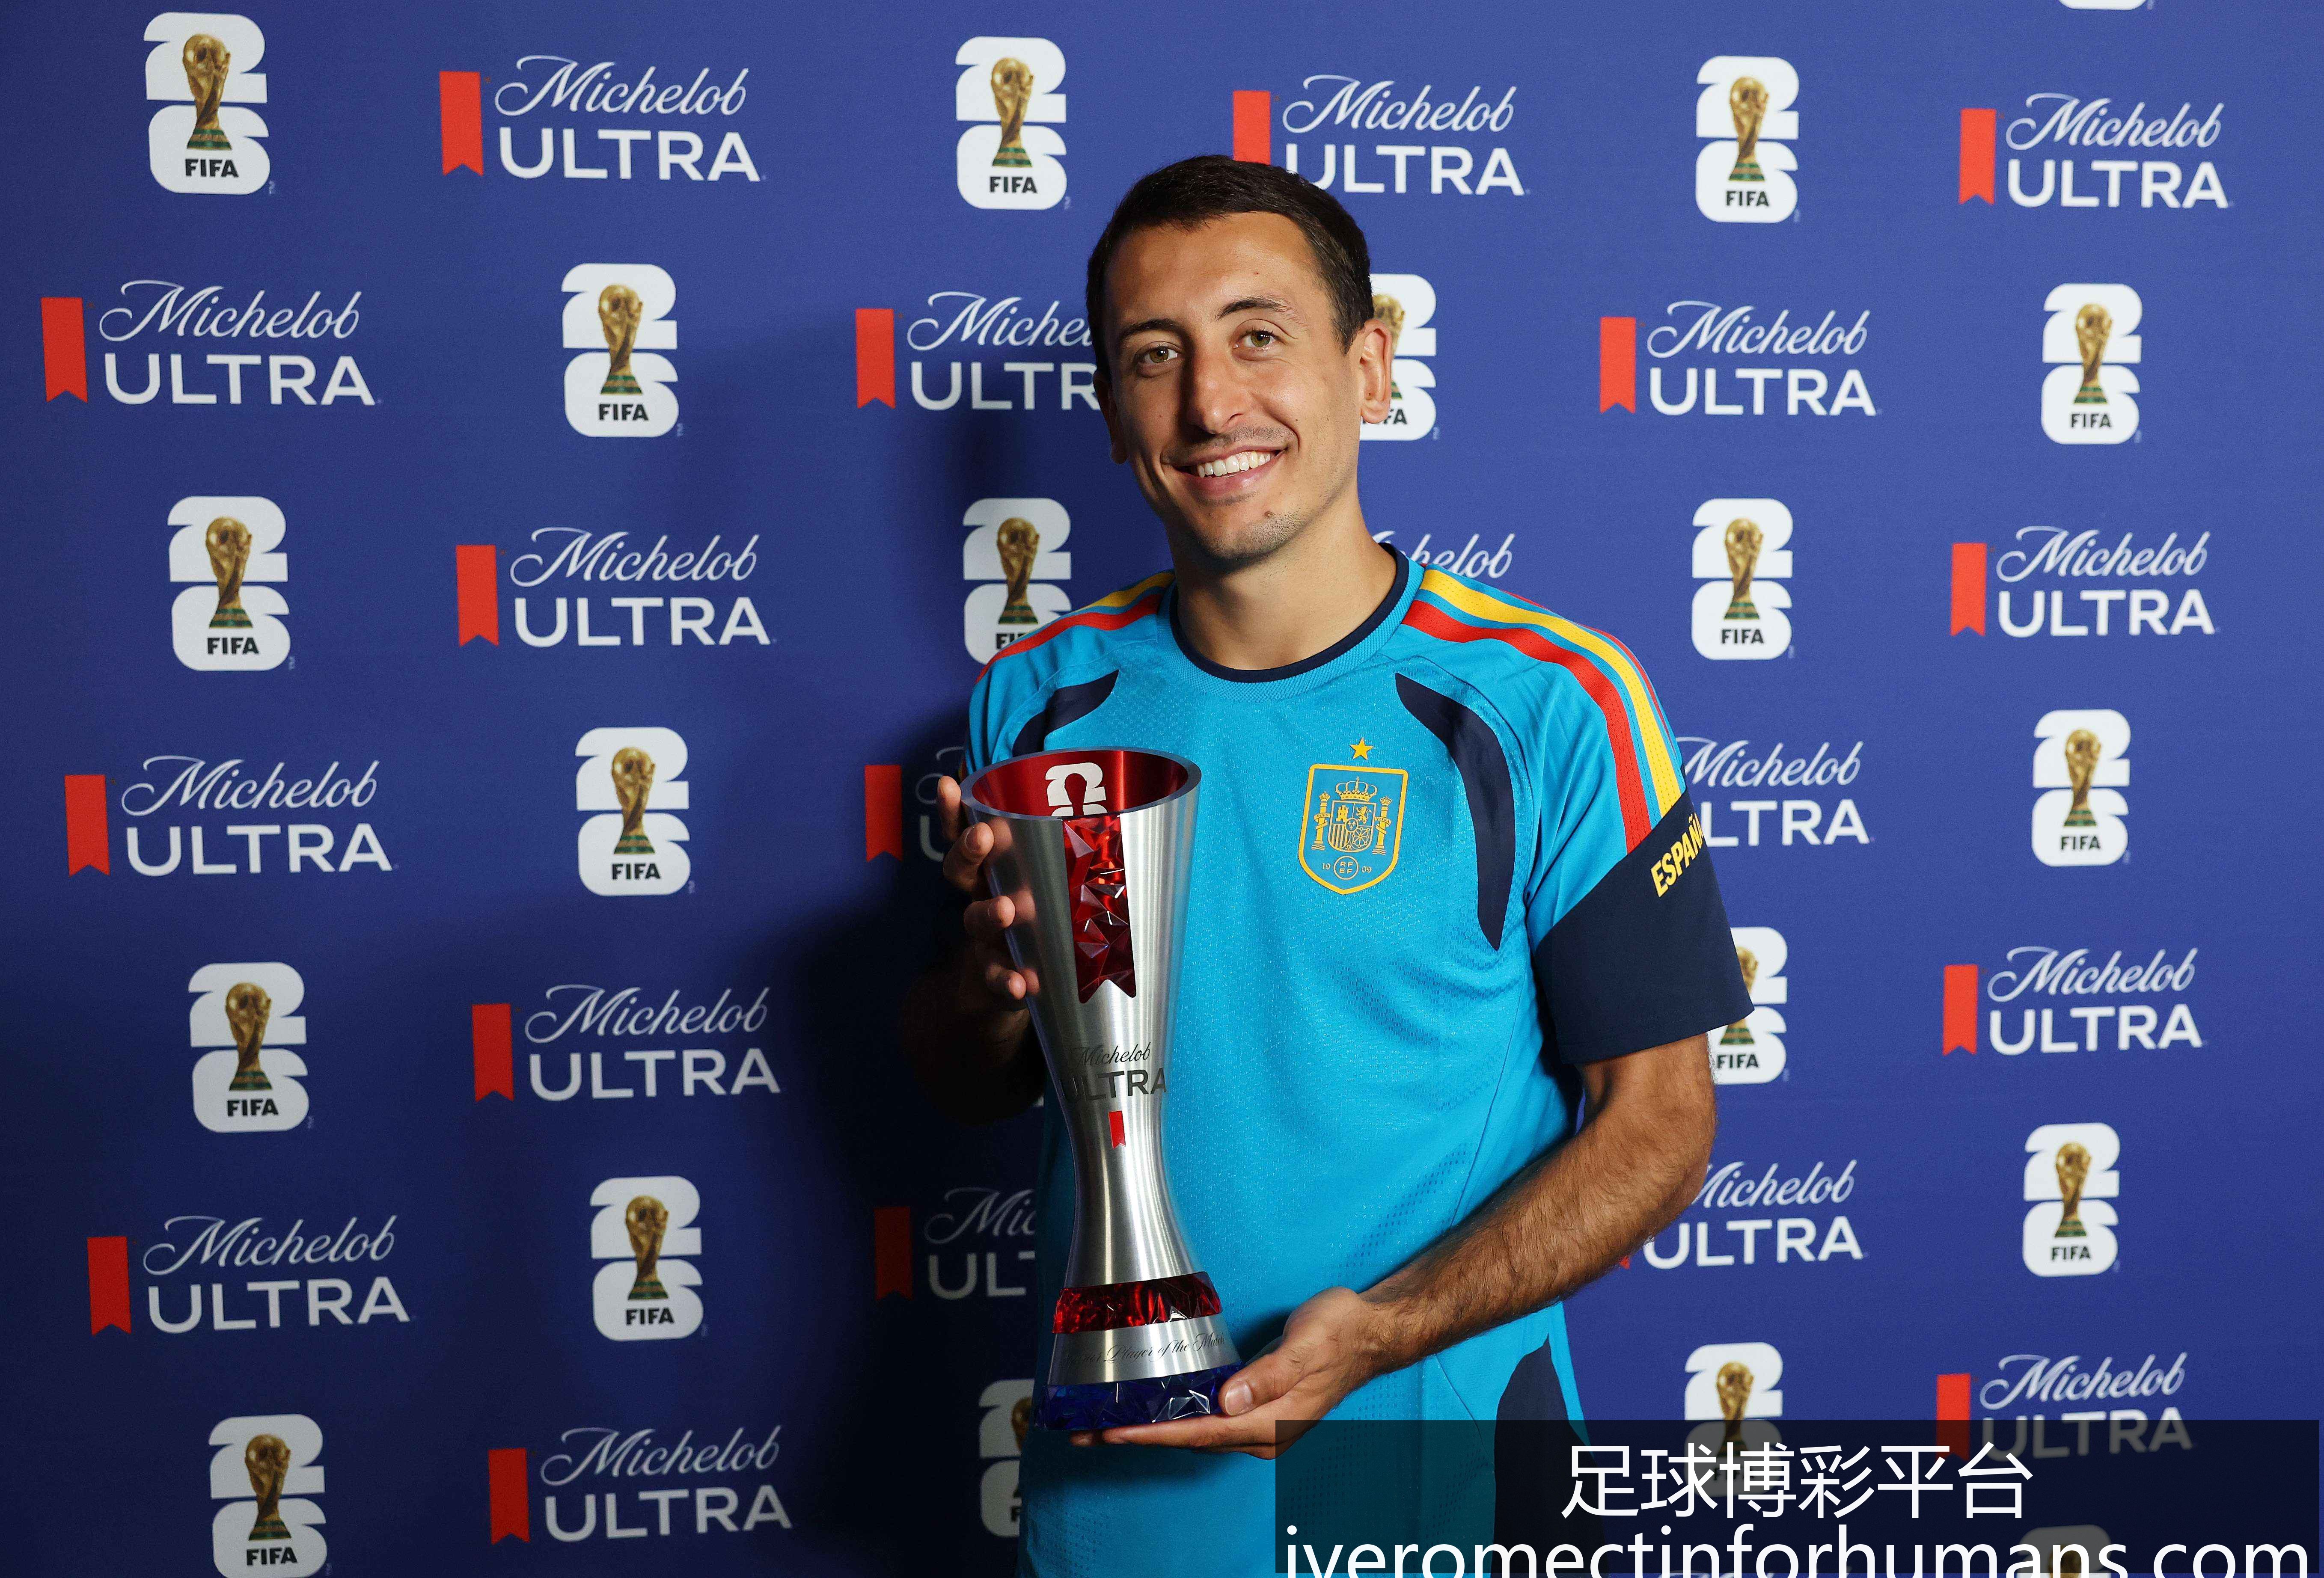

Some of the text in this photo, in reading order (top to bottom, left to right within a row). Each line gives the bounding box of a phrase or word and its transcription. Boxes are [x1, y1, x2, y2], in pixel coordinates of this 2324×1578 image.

[495, 56, 749, 116] Michelob
[1283, 75, 1516, 133] Michelob
[2006, 93, 2224, 150] Michelob
[185, 159, 238, 177] FIFA
[500, 127, 760, 181] ULTRA
[1286, 144, 1524, 196] ULTRA
[990, 176, 1037, 193] FIFA
[1727, 191, 1769, 206] FIFA
[2008, 159, 2228, 208] ULTRA
[100, 280, 361, 341] Michelob
[907, 291, 1091, 350] Miche
[1647, 301, 1870, 358] Michelob
[105, 353, 375, 405] ULTRA
[911, 361, 1100, 410] ULTR
[1650, 368, 1876, 415] ULTRA
[599, 404, 648, 421] FIFA
[2071, 413, 2111, 427] FIFA
[511, 528, 759, 587] Michelob
[1997, 526, 2210, 582] Michelob
[515, 597, 770, 647] ULTRA
[1722, 629, 1764, 644] FIFA
[1999, 589, 2214, 638] ULTRA
[207, 638, 259, 654] FIFA
[122, 756, 379, 816] Michelob
[1700, 799, 1870, 847] LTRA
[2061, 836, 2101, 850] FIFA
[127, 824, 392, 876] ULTRA
[612, 863, 660, 880] FIFA
[1988, 946, 2197, 1002] Michelob
[525, 985, 768, 1043] Michelob
[1990, 1004, 2202, 1055] ULTRA
[530, 1049, 779, 1101] ULTRA
[1076, 1042, 1151, 1068] Michelob
[1717, 1053, 1759, 1068] FIFA
[227, 1099, 278, 1116] FIFA
[1059, 1068, 1166, 1101] ULTRA
[143, 1215, 396, 1275] Michelob
[1643, 1216, 1864, 1270] ULTRA
[2052, 1246, 2090, 1261] FIFA
[149, 1277, 409, 1333] ULTRA
[626, 1308, 674, 1325] FIFA
[1104, 1344, 1156, 1363] Player
[1157, 1340, 1178, 1360] of
[1172, 1339, 1190, 1353] the
[1980, 1353, 2187, 1409] Michelob
[541, 1426, 780, 1483] Michelob
[1982, 1407, 2193, 1462] ULTRA
[546, 1485, 791, 1542] ULTRA
[247, 1548, 297, 1566] FIFA
